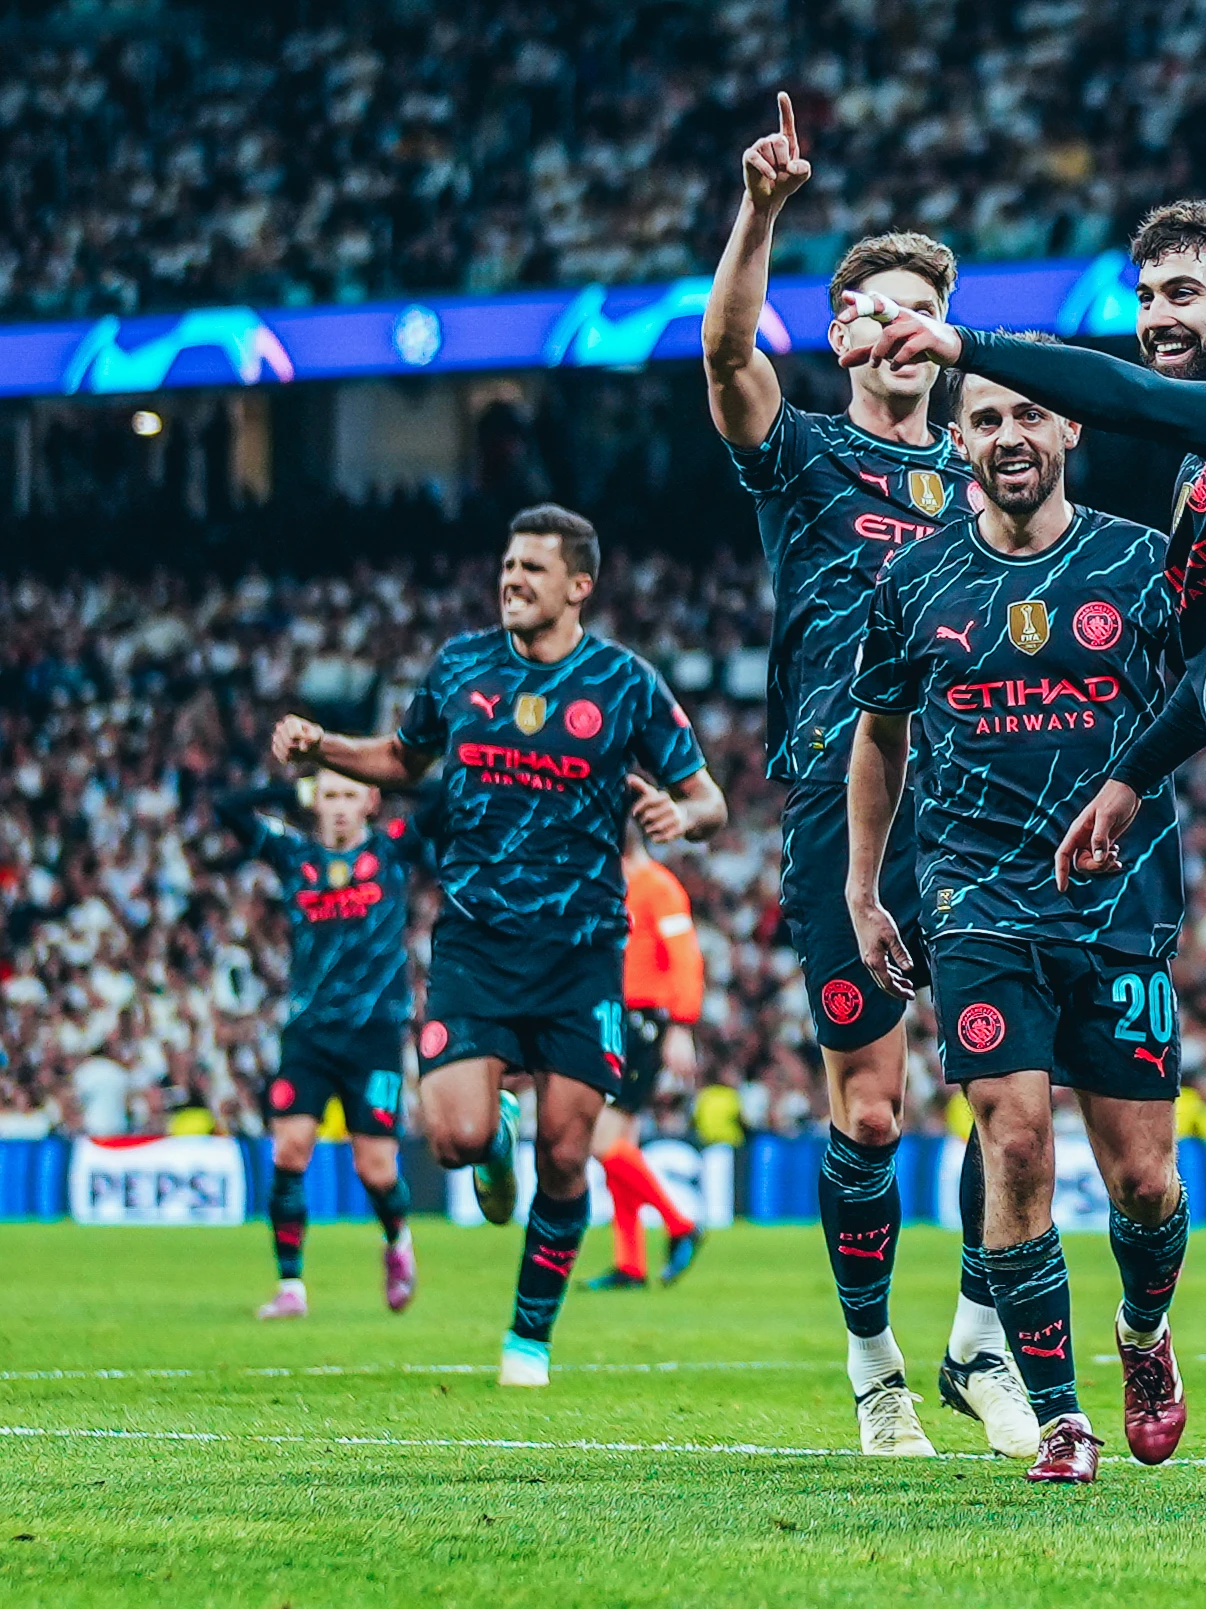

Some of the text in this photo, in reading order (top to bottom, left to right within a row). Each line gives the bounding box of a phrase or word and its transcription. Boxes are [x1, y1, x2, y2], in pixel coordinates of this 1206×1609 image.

[854, 513, 935, 544] ETI
[947, 675, 1121, 711] ETIHAD
[976, 710, 1096, 735] AIRWAYS
[458, 742, 591, 780] ETIHAD
[1111, 970, 1173, 1043] 20
[90, 1169, 227, 1209] PEPSI
[839, 1223, 890, 1240] CITY
